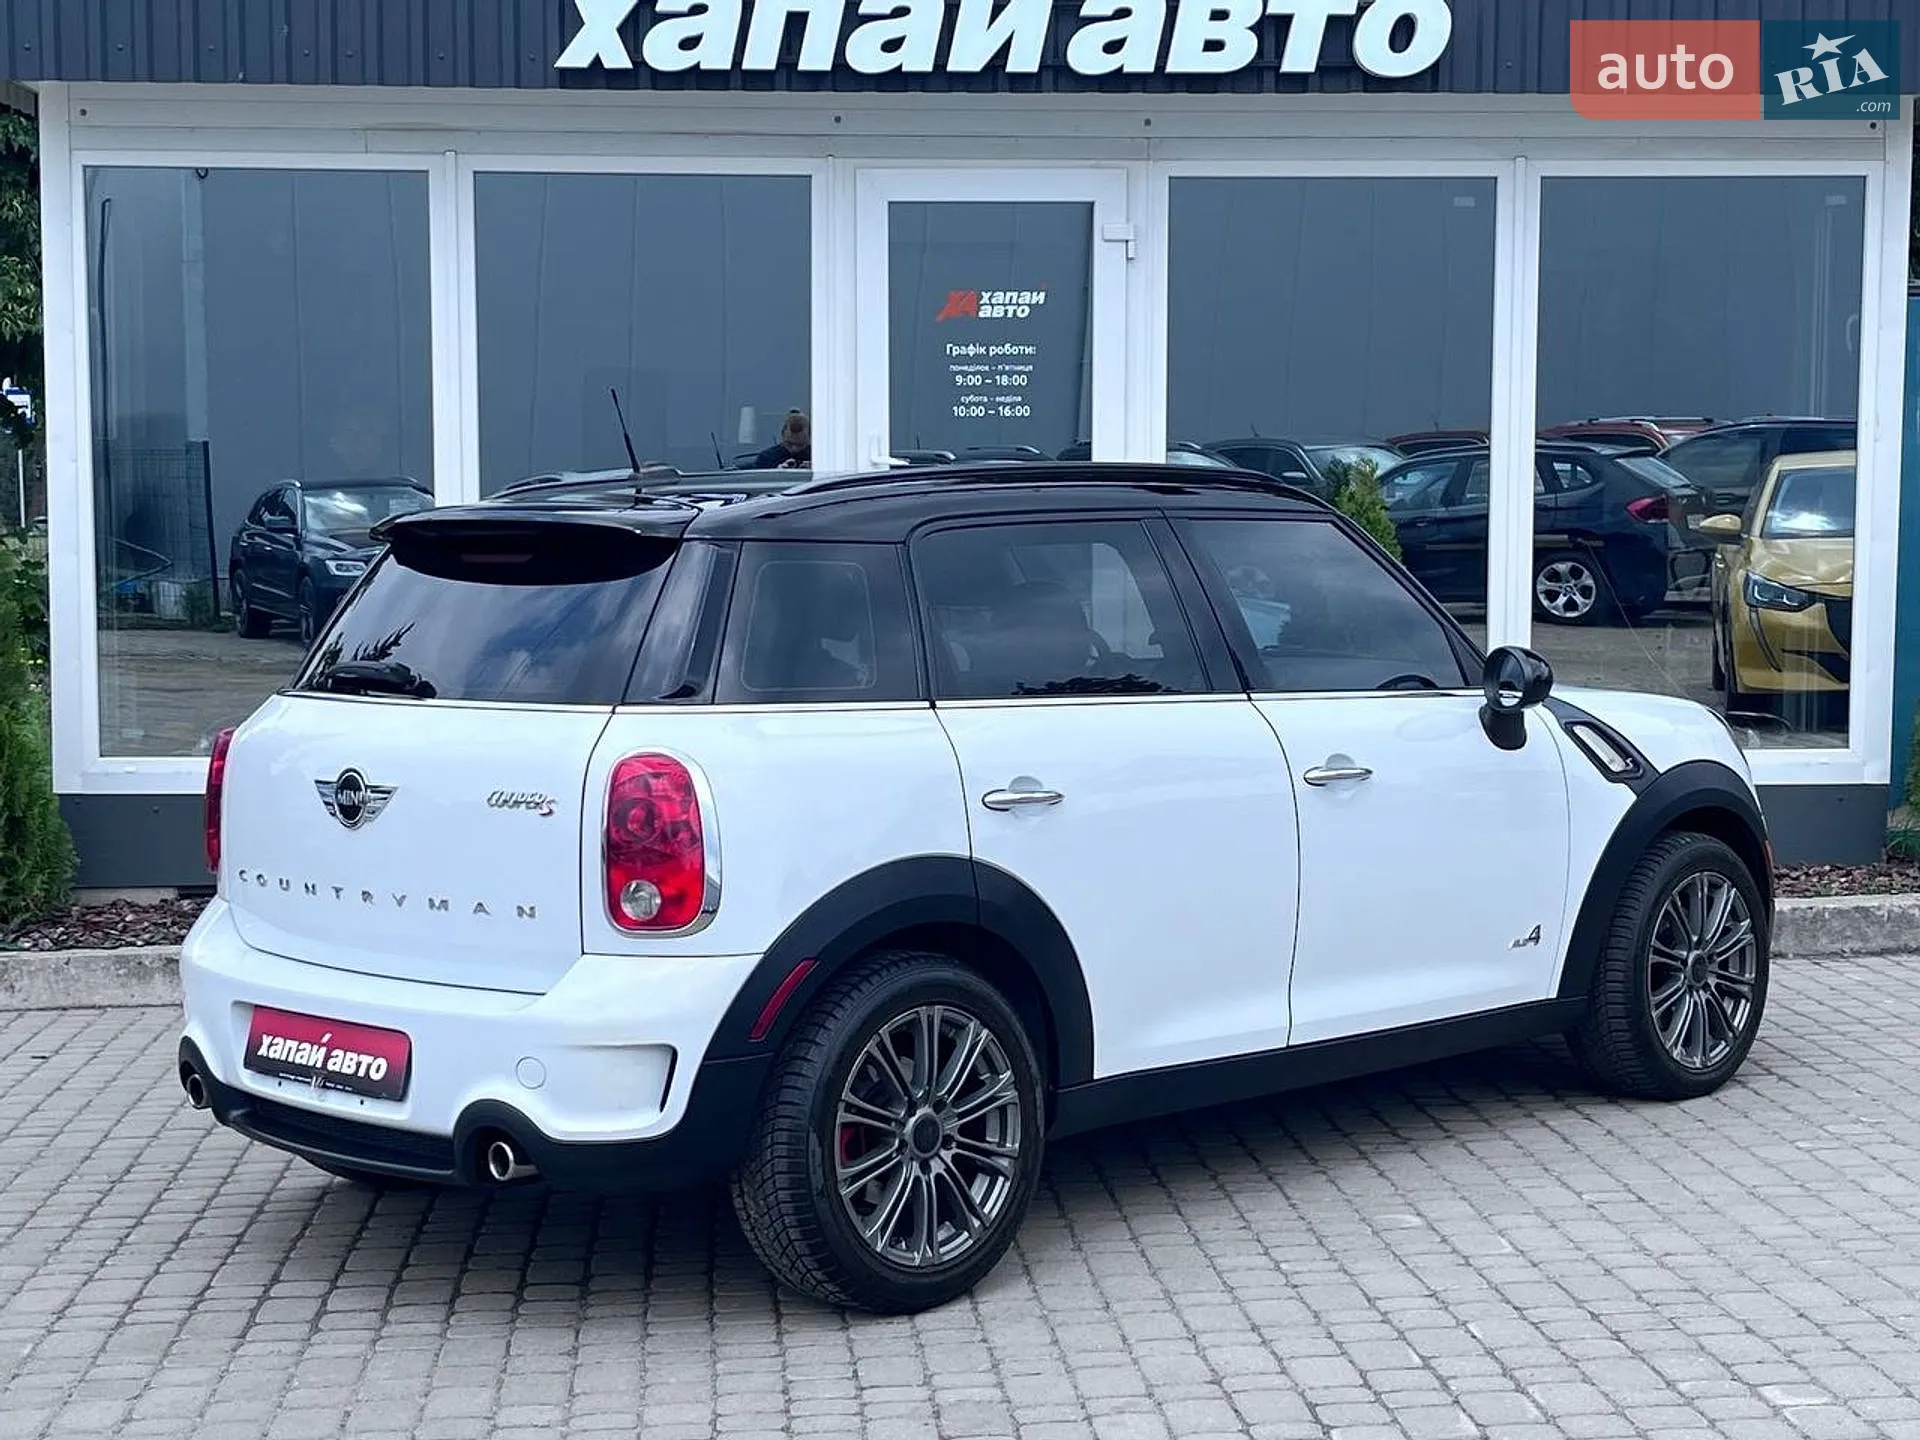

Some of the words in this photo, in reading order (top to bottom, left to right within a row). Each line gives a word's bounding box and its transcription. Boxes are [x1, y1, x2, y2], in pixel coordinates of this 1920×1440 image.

[1065, 0, 1454, 78] авто
[978, 304, 1031, 318] авто
[946, 343, 986, 357] Графік
[989, 343, 1036, 357] роботи:
[955, 374, 982, 386] 9:00
[995, 374, 1028, 386] 18:00
[952, 405, 986, 417] 10:00
[998, 405, 1031, 417] 16:00
[238, 868, 537, 920] COUNTRYMAN
[326, 1048, 388, 1082] авто
